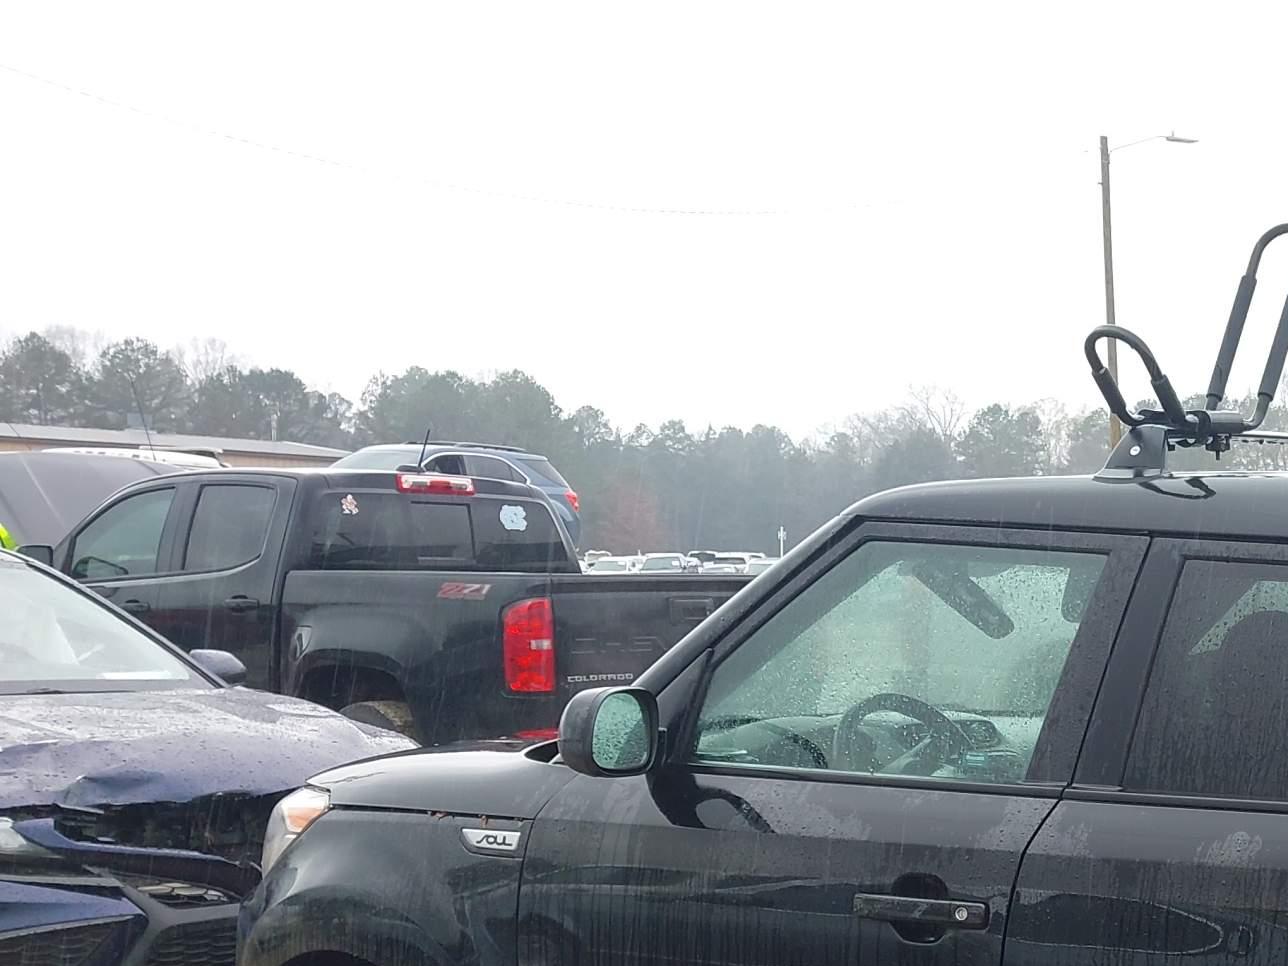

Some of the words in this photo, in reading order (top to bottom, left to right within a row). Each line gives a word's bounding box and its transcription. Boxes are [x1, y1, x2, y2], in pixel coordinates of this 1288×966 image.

[437, 583, 492, 600] Z71
[567, 673, 634, 683] COLORADO
[475, 834, 513, 847] SOUL
